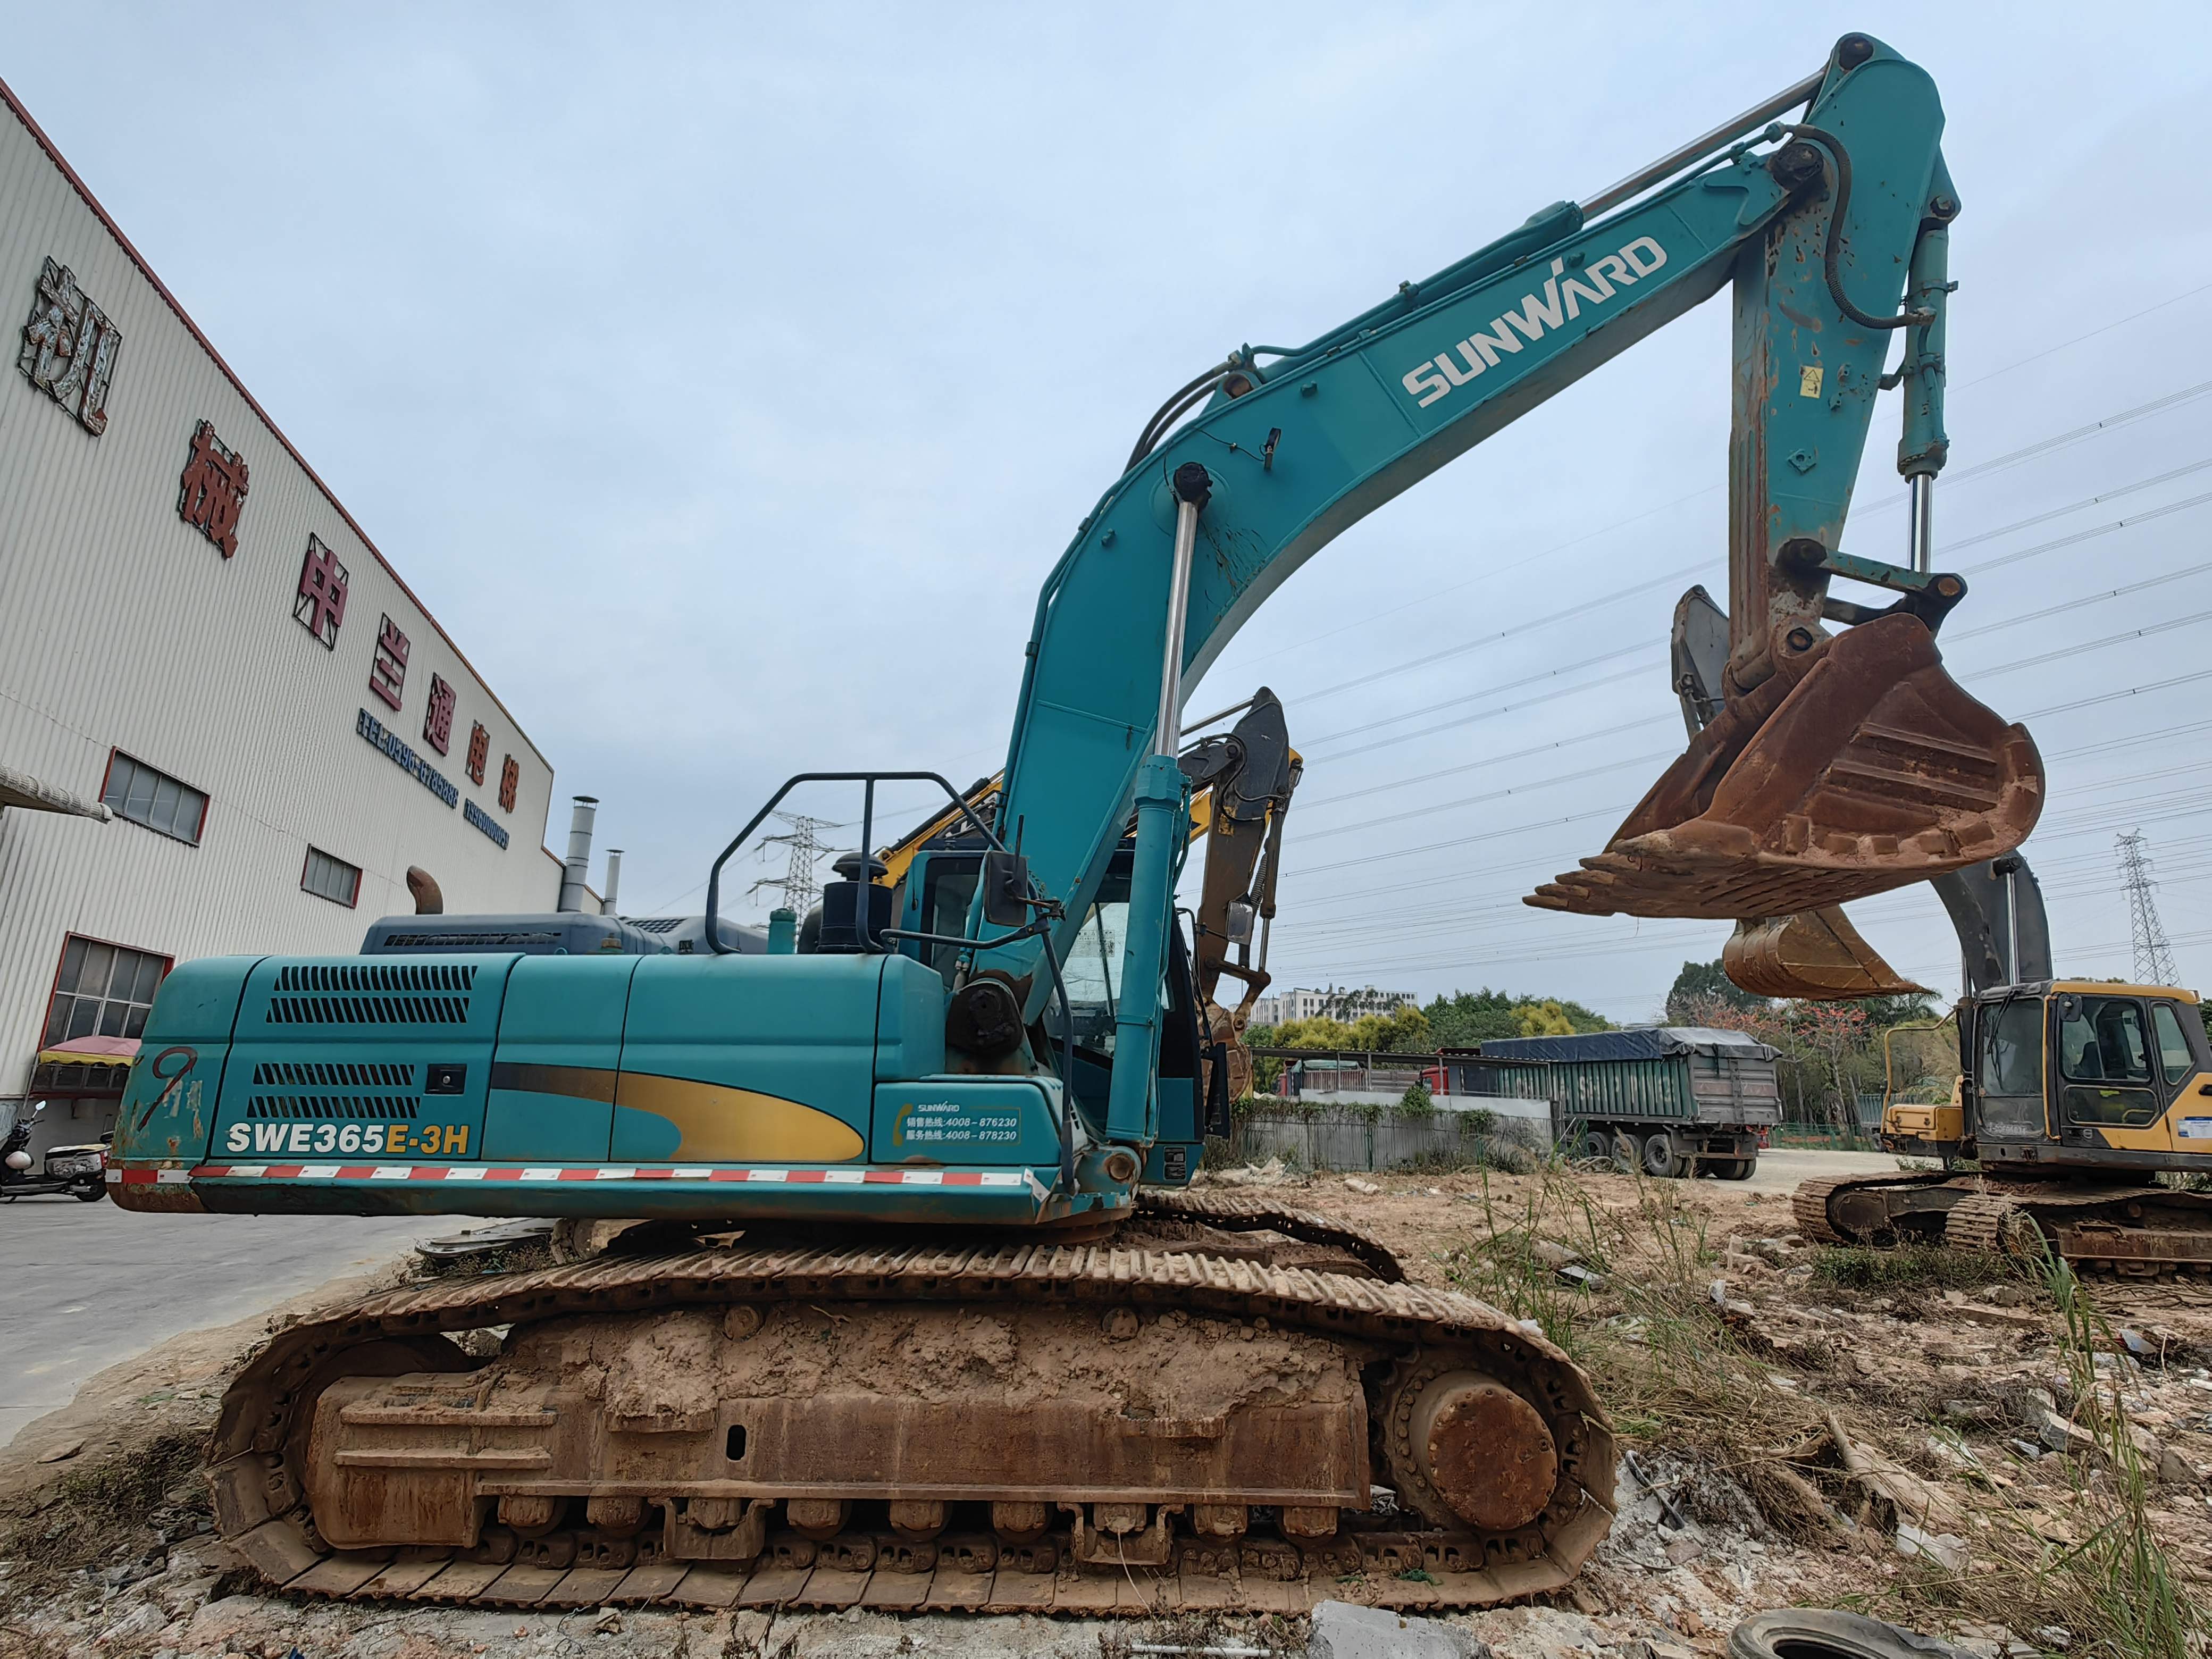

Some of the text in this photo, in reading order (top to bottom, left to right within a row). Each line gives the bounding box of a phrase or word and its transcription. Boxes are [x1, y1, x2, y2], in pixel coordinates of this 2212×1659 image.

[1402, 236, 1668, 408] SUNWARD
[918, 1101, 960, 1112] SUNWARD
[226, 1122, 469, 1154] SWE365E-3H
